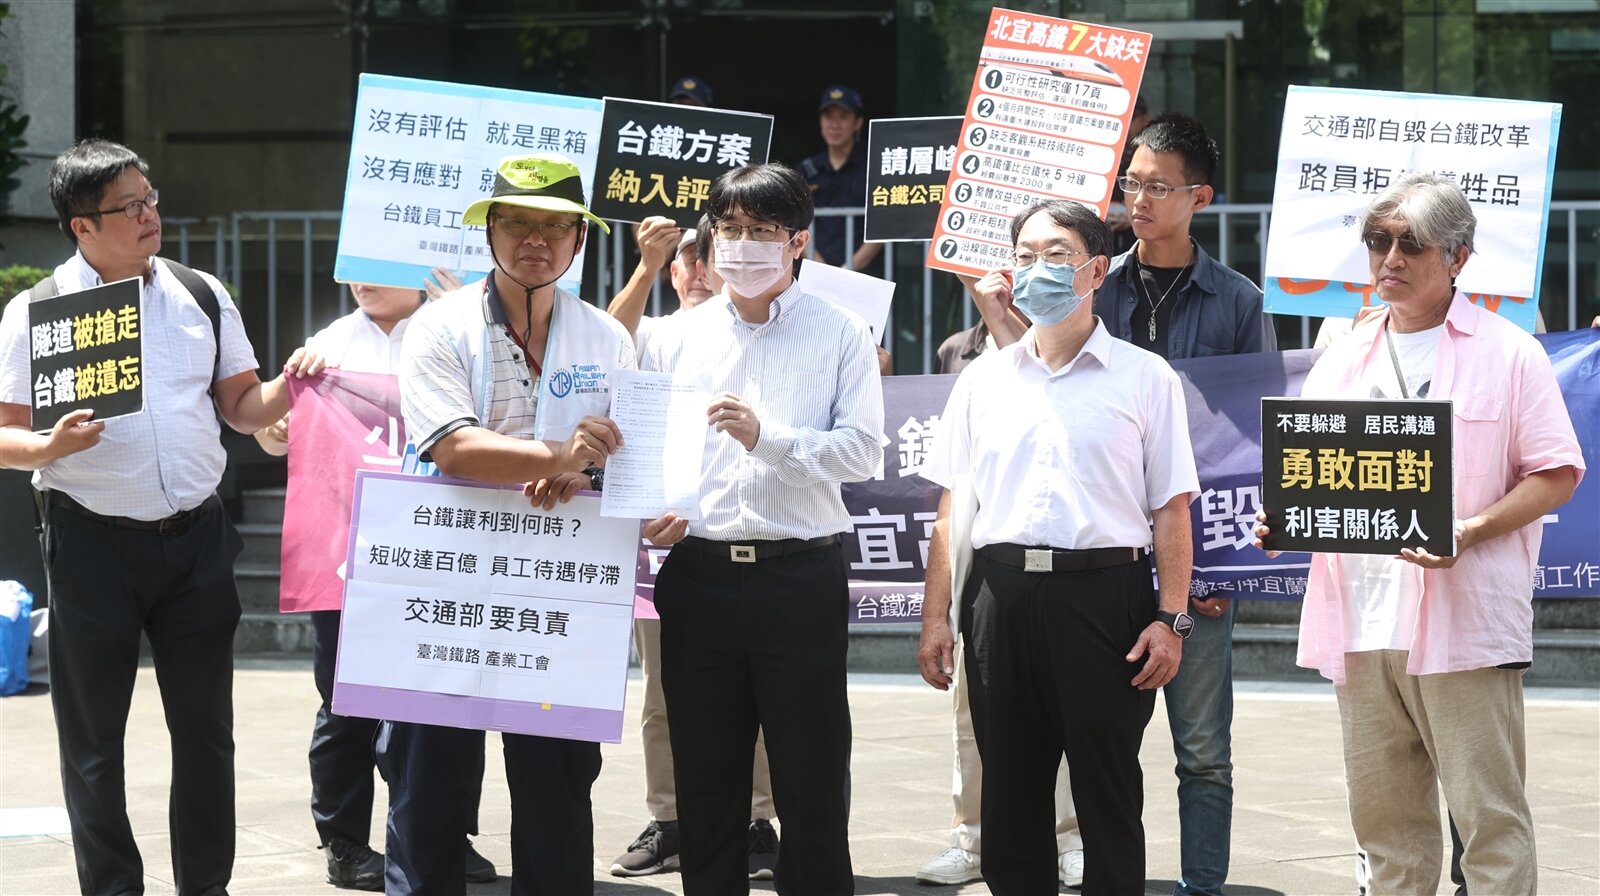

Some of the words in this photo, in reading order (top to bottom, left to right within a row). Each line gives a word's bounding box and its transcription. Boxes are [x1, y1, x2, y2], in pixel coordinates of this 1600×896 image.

[990, 15, 1144, 63] 北宜高鐵7大缺失
[988, 70, 1001, 89] 1
[1005, 71, 1102, 99] 可行性研究僅17頁
[979, 99, 992, 117] 2
[368, 108, 469, 141] 沒有評估
[486, 120, 588, 154] 就是黑箱
[617, 120, 752, 168] 台鐵方案
[972, 128, 985, 146] 3
[1301, 114, 1530, 149] 交通部自毀台鐵改革
[362, 155, 463, 190] 沒有應對
[964, 156, 978, 173] 4
[1054, 168, 1062, 181] 5
[1019, 177, 1043, 189] 2300
[1298, 163, 1521, 206] 路員拒牲品
[606, 167, 711, 211] 納入評
[872, 184, 946, 206] 台鐵公司
[949, 212, 963, 230] 6
[942, 240, 956, 258] 7
[31, 304, 139, 360] 隧道被搶走
[34, 355, 141, 409] 台鐵被遺忘
[1277, 413, 1346, 434] 不要躲避
[1364, 415, 1435, 435] 居民溝通
[1281, 448, 1433, 493] 勇敢面對
[413, 504, 582, 538] 台鐵讓利到何時？
[1285, 506, 1429, 542] 利害關係人
[369, 544, 478, 575] 短收達百億
[490, 555, 621, 586] 員工待遇停滯
[404, 597, 484, 628] 交通部
[489, 605, 570, 638] 要負責
[416, 643, 480, 665] 臺灣鐵路
[485, 650, 550, 671] 產業工會
